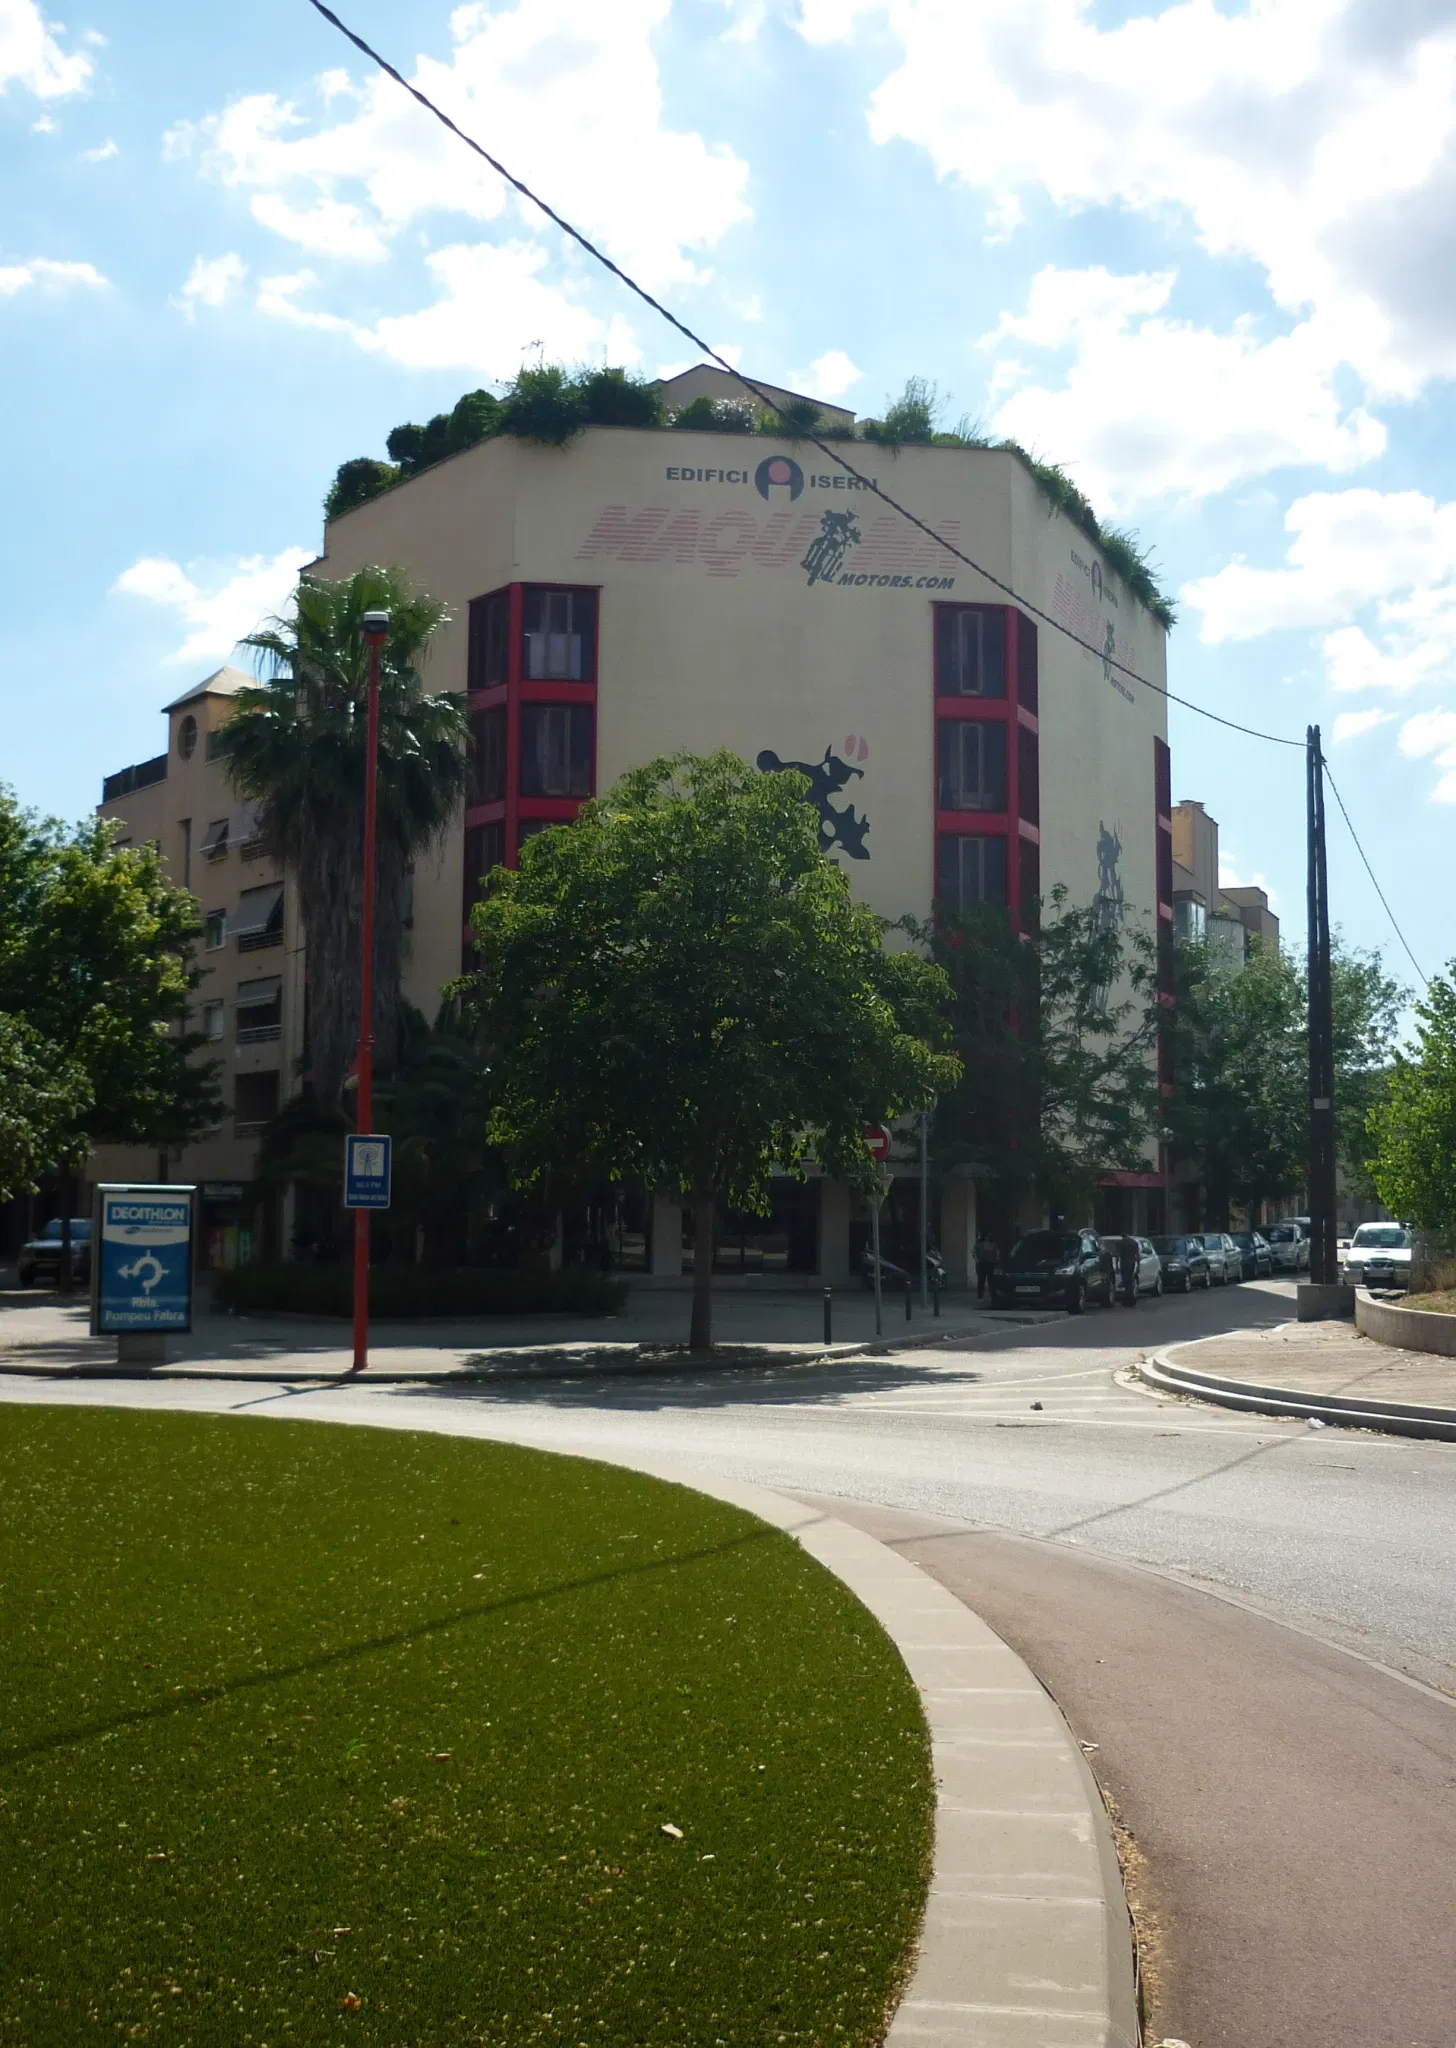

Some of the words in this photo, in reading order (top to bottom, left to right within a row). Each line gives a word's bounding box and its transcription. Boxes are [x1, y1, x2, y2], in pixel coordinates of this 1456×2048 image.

[665, 466, 748, 484] EDIFICI
[809, 474, 877, 492] ISERN
[836, 573, 955, 591] MOTORS.COM
[111, 1206, 185, 1221] DECATHLON
[105, 1310, 151, 1324] Pompeu
[153, 1308, 185, 1321] Fabra
